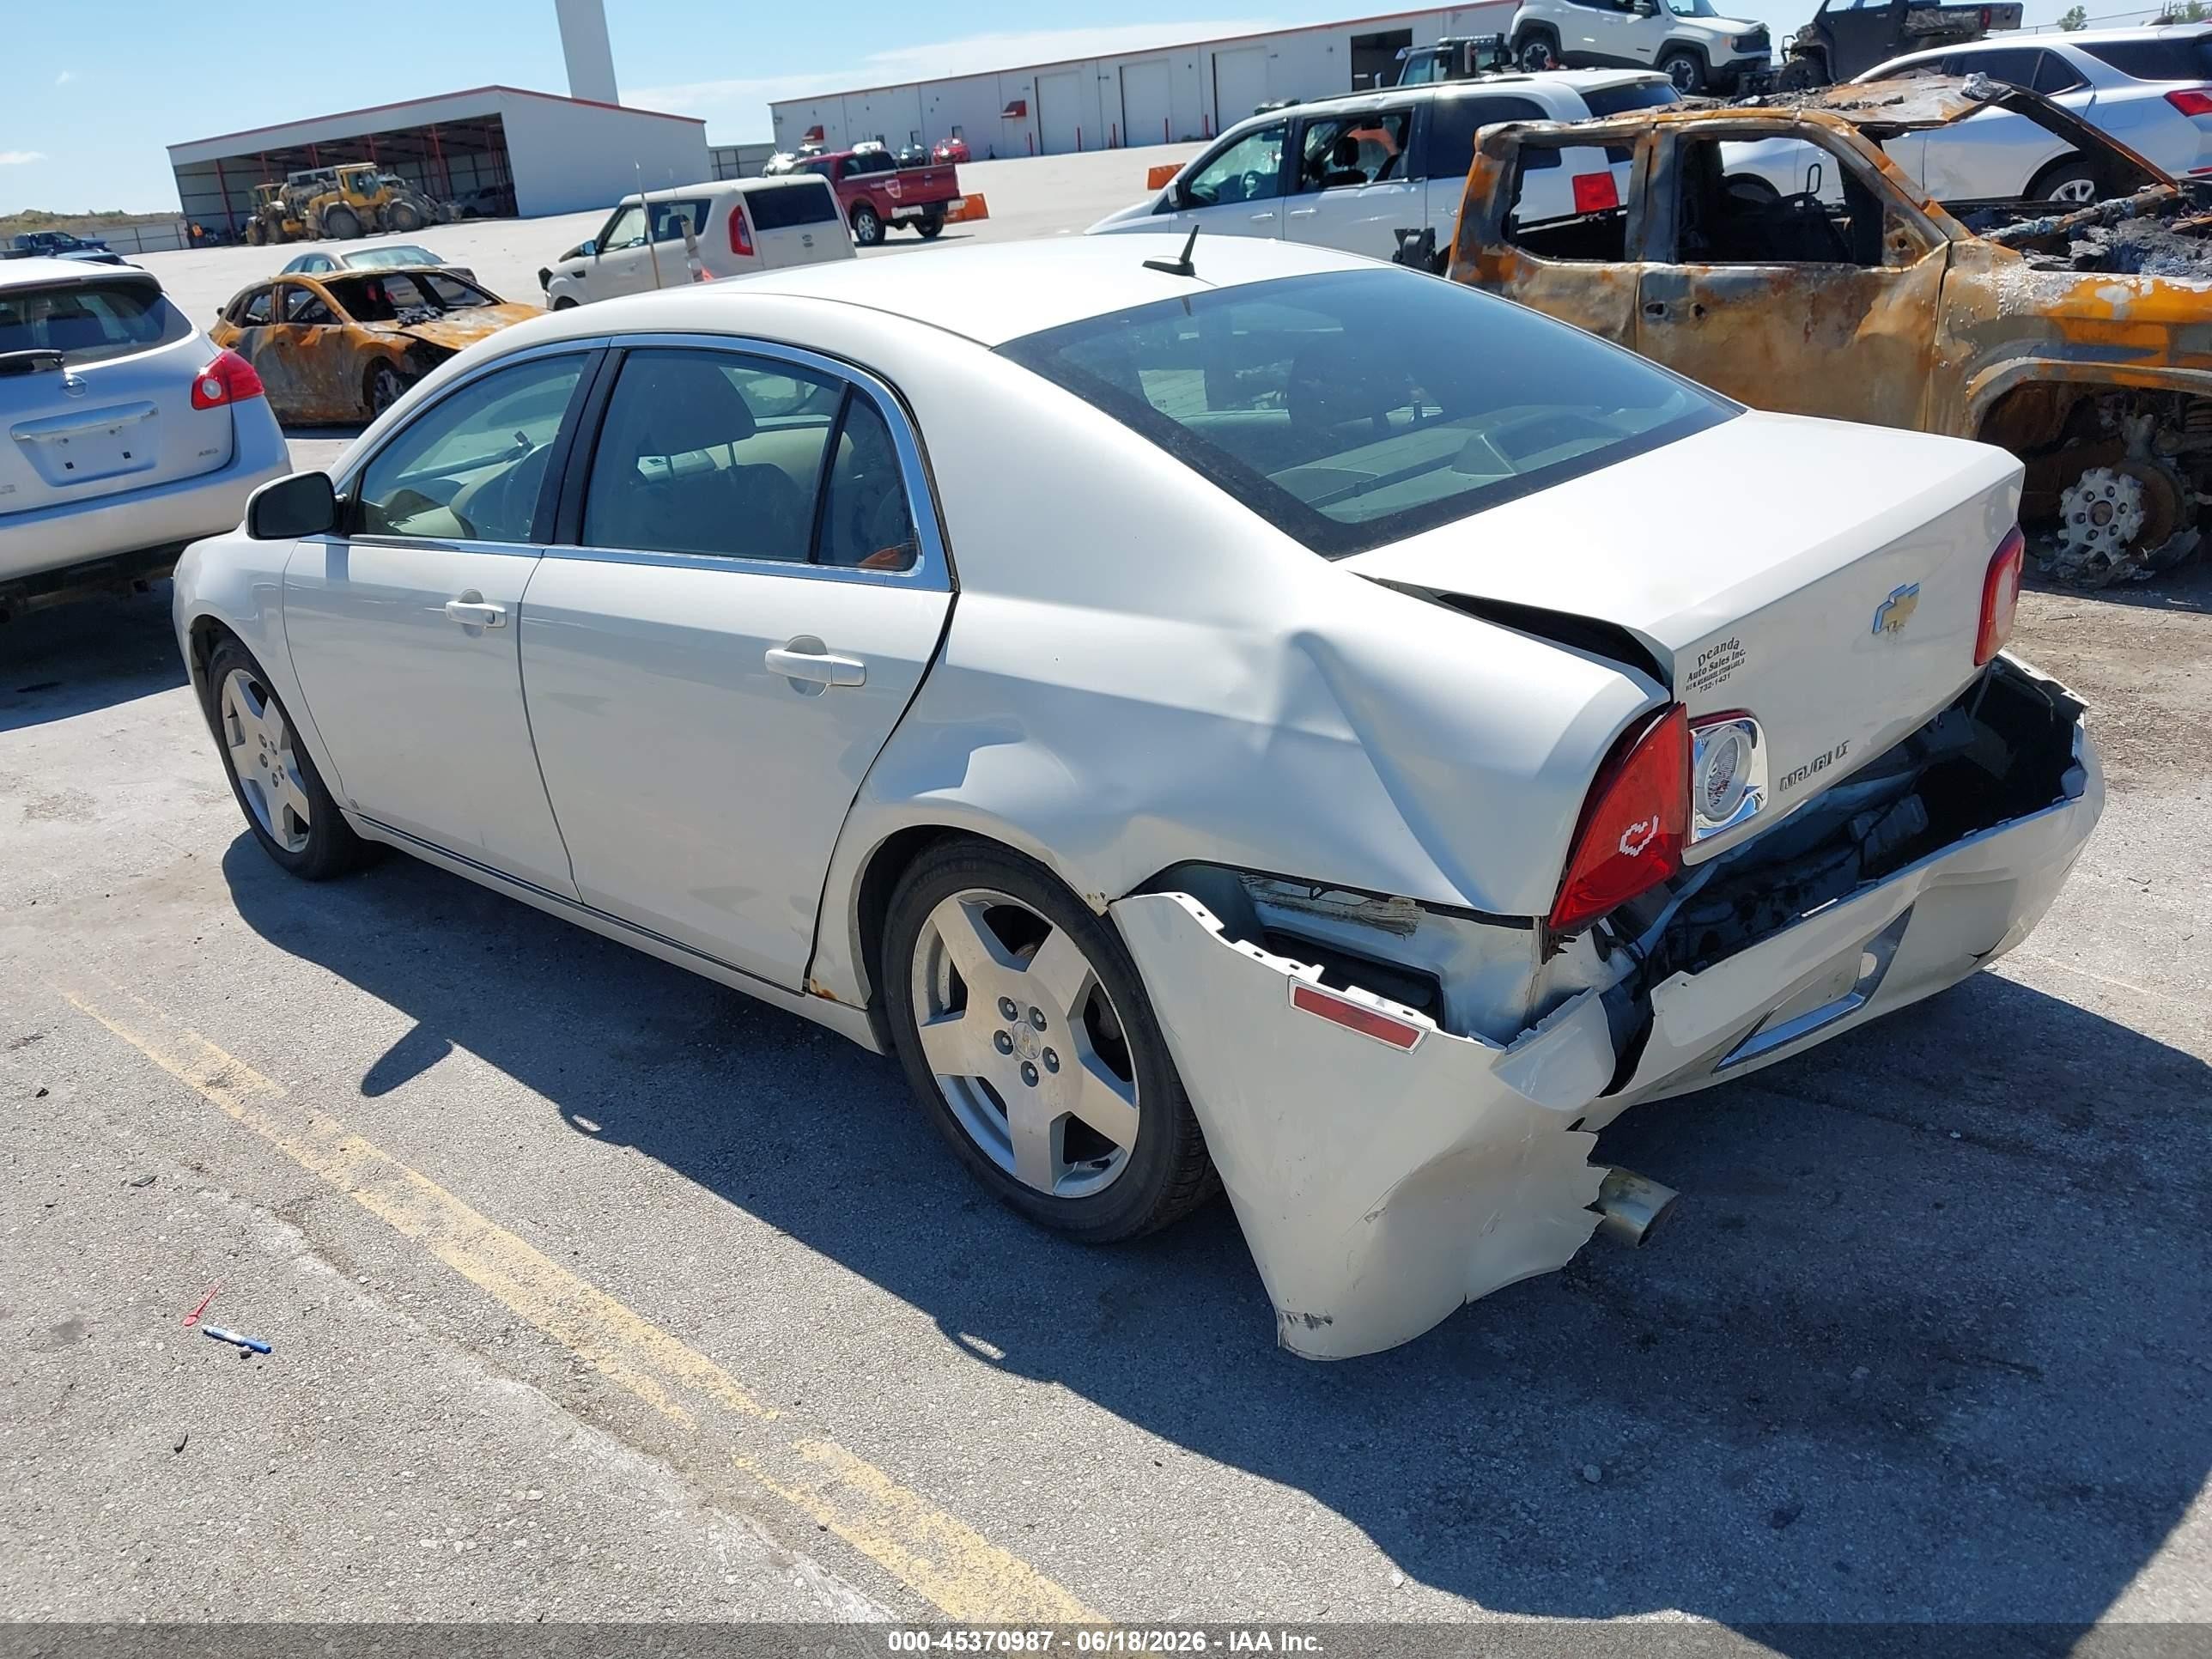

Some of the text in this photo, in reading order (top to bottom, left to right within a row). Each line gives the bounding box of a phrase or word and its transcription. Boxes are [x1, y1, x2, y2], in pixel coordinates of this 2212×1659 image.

[1686, 666, 1707, 684] Auto
[1708, 655, 1730, 672] Sales
[1730, 648, 1747, 661] Inc.
[1697, 636, 1741, 668] Deanda
